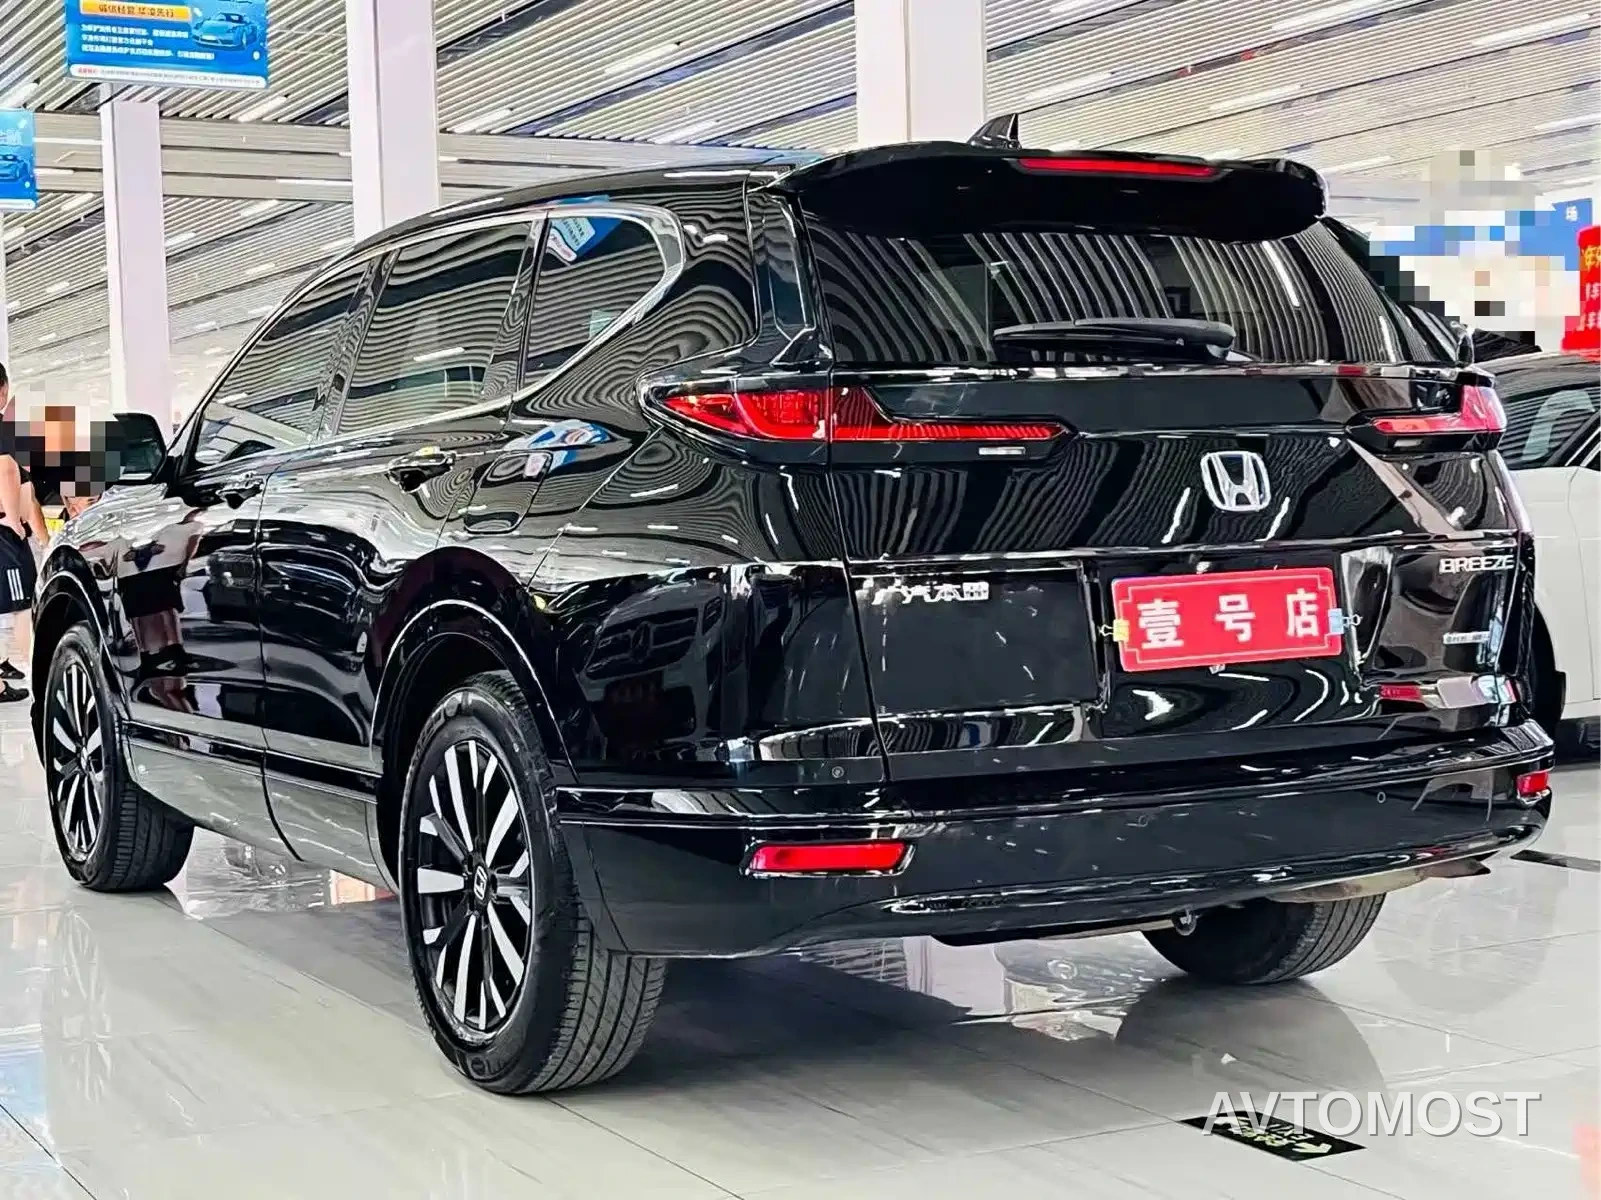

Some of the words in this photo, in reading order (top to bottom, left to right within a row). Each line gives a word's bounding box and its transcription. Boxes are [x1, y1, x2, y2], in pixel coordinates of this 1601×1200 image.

[1439, 554, 1515, 574] BREEZE
[1137, 587, 1320, 650] 壹号店
